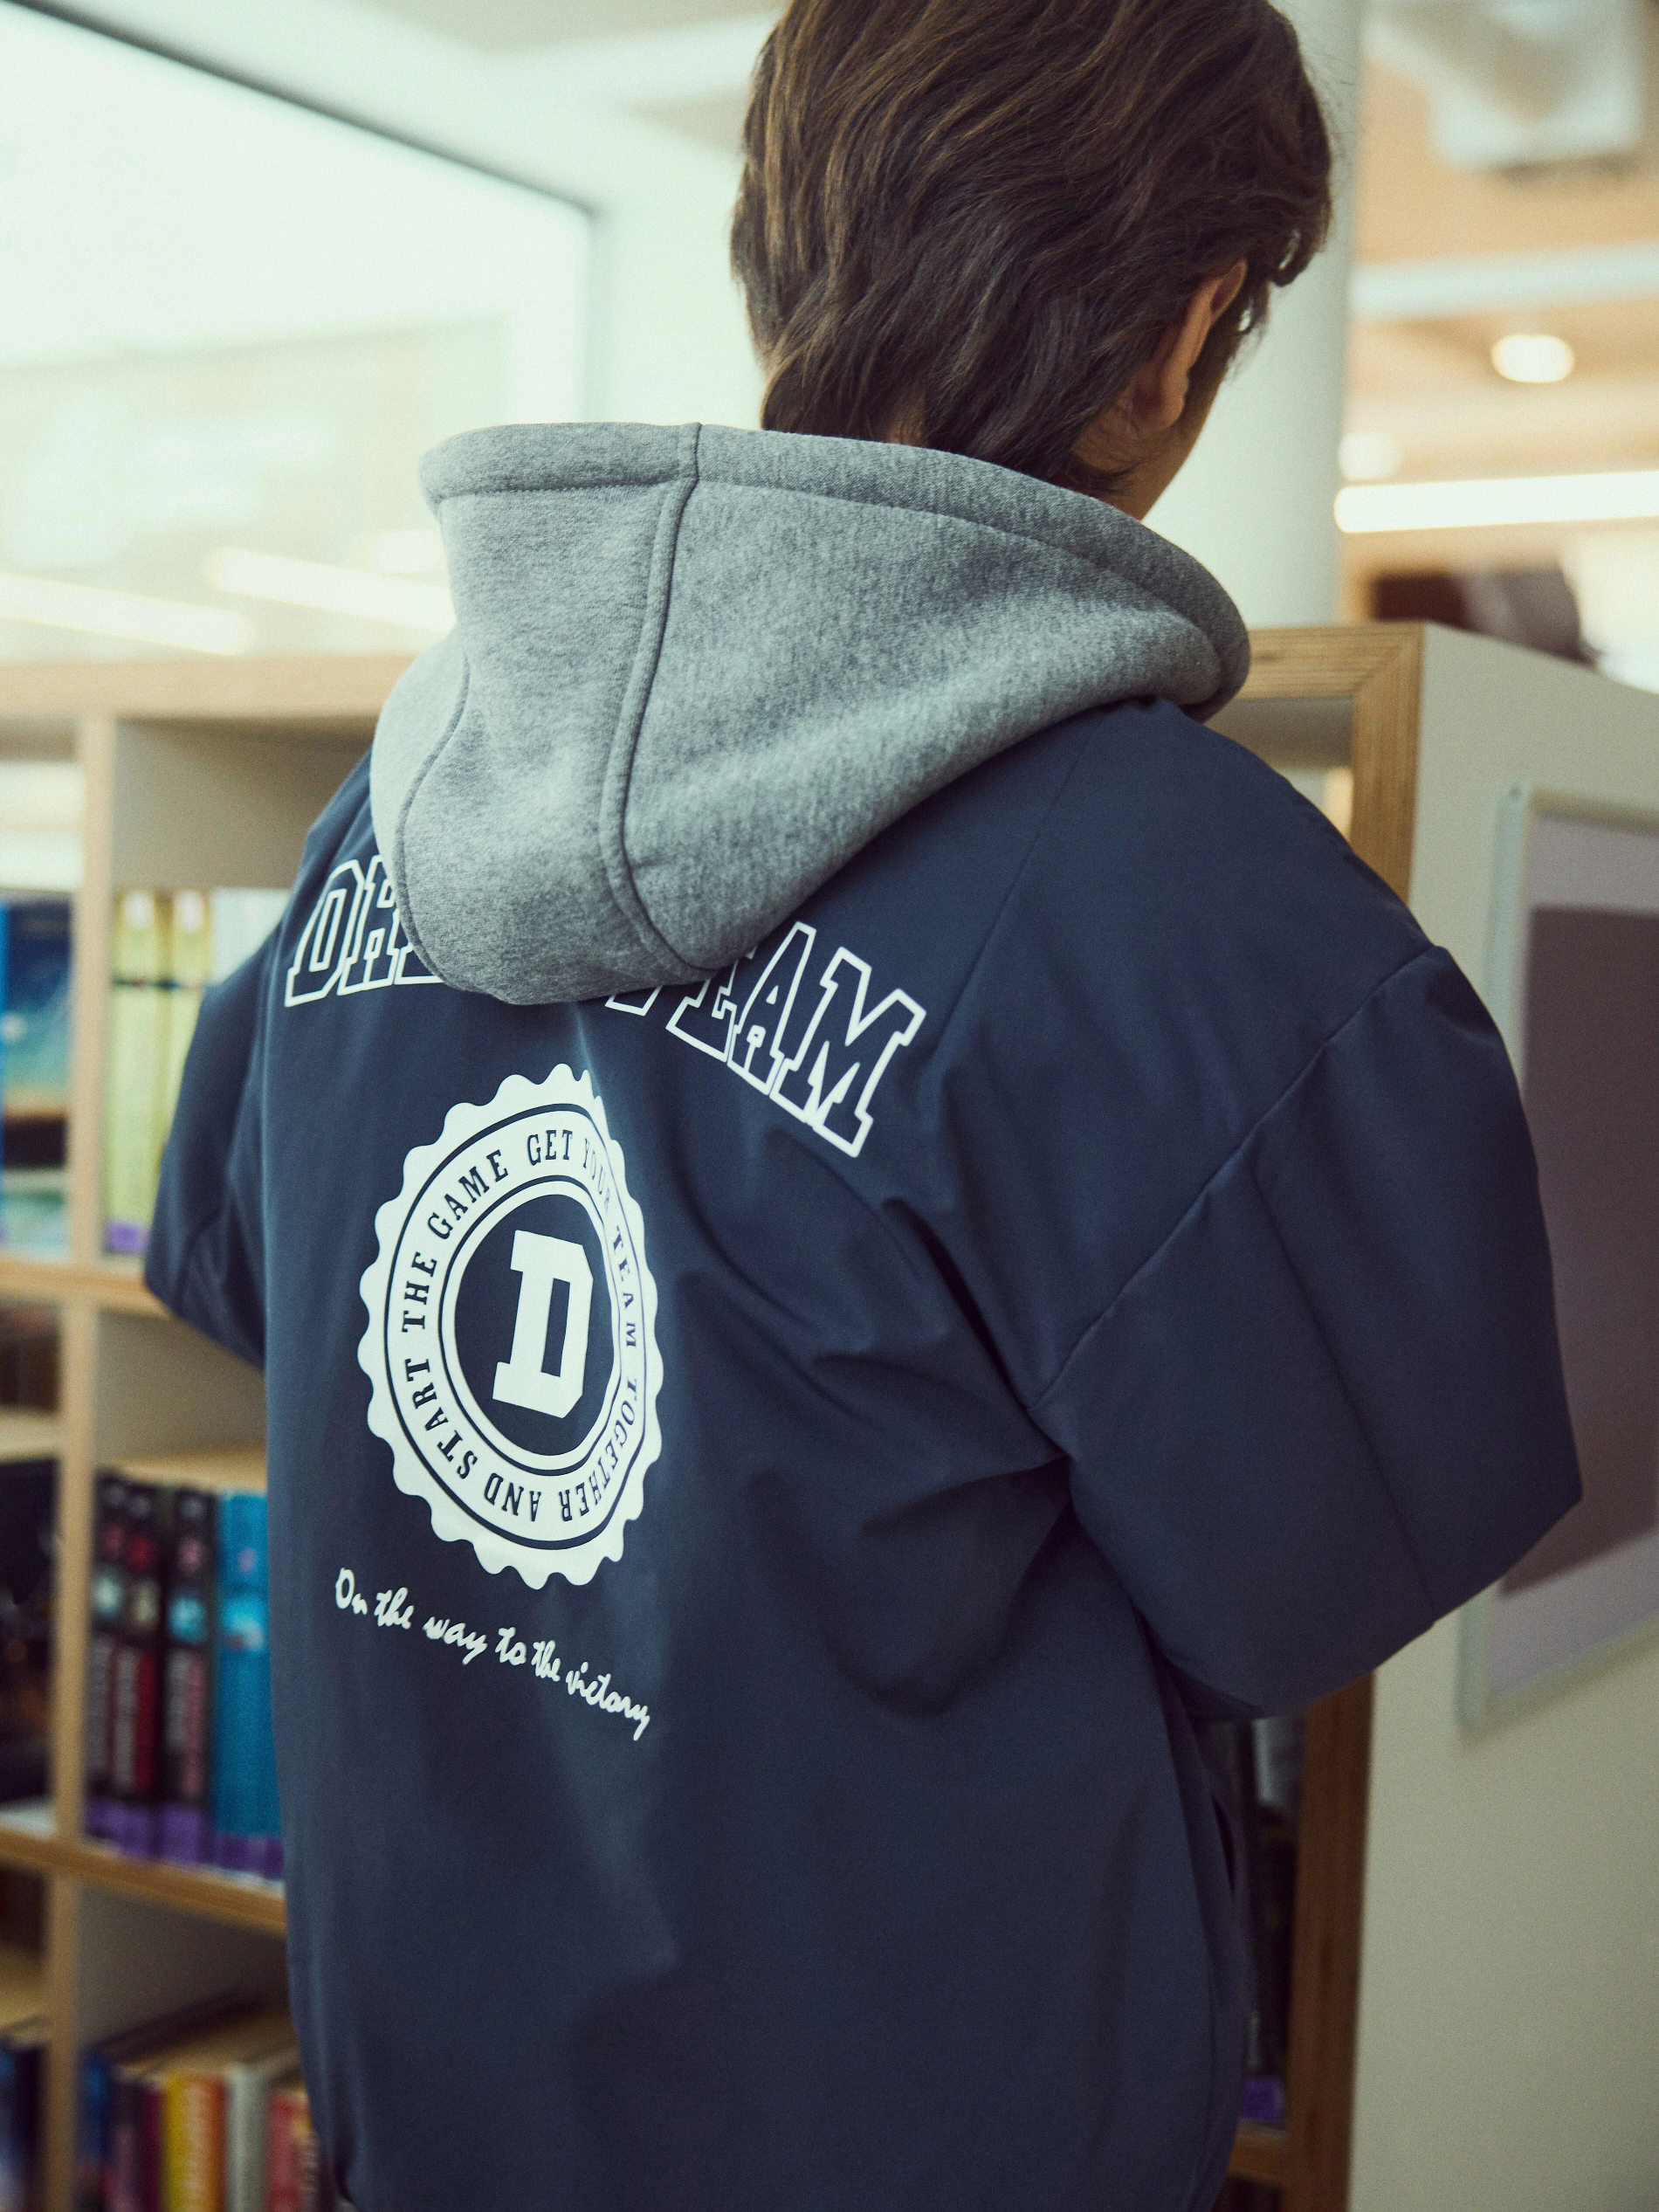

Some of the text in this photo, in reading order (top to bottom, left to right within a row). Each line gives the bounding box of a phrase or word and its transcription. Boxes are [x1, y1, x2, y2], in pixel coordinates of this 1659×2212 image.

[604, 920, 927, 1159] EAM
[427, 1149, 509, 1240] GAME
[527, 1129, 573, 1166] GET
[401, 1251, 437, 1333] THE
[492, 1229, 595, 1419] D
[613, 1224, 637, 1347] TEAM
[404, 1357, 478, 1479] START
[558, 1375, 637, 1522] TOGETHER
[483, 1472, 542, 1522] AND
[335, 1567, 651, 1741] On the way to the victory
